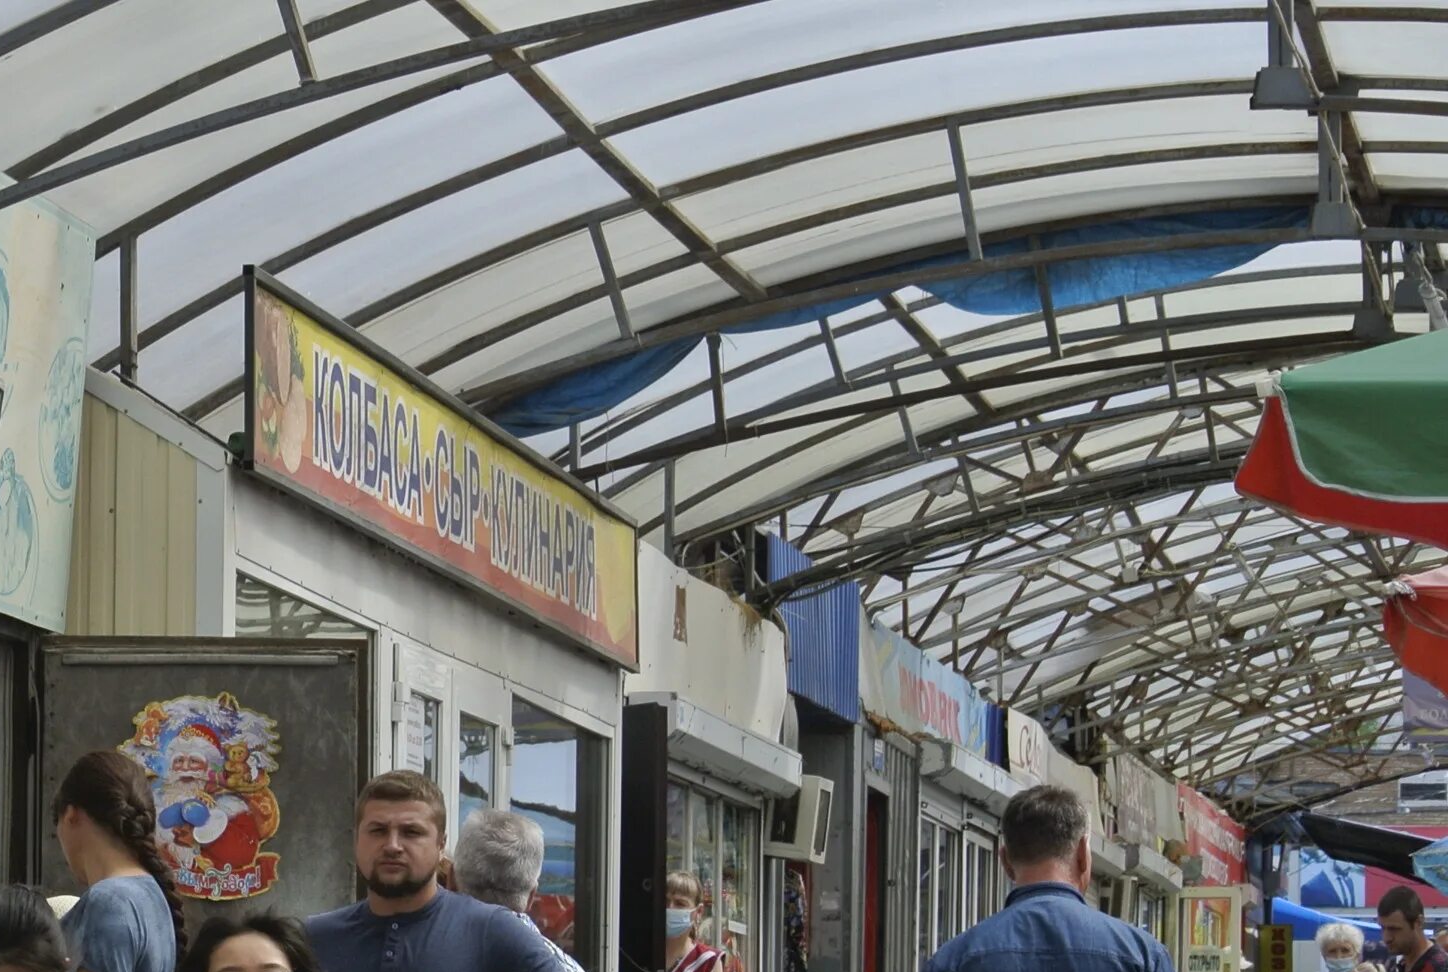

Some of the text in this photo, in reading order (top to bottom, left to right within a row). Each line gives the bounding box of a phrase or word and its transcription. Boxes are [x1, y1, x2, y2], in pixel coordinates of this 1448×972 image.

[311, 342, 597, 620] КОЛБАСА СЫР КУЛИНАРИЯ
